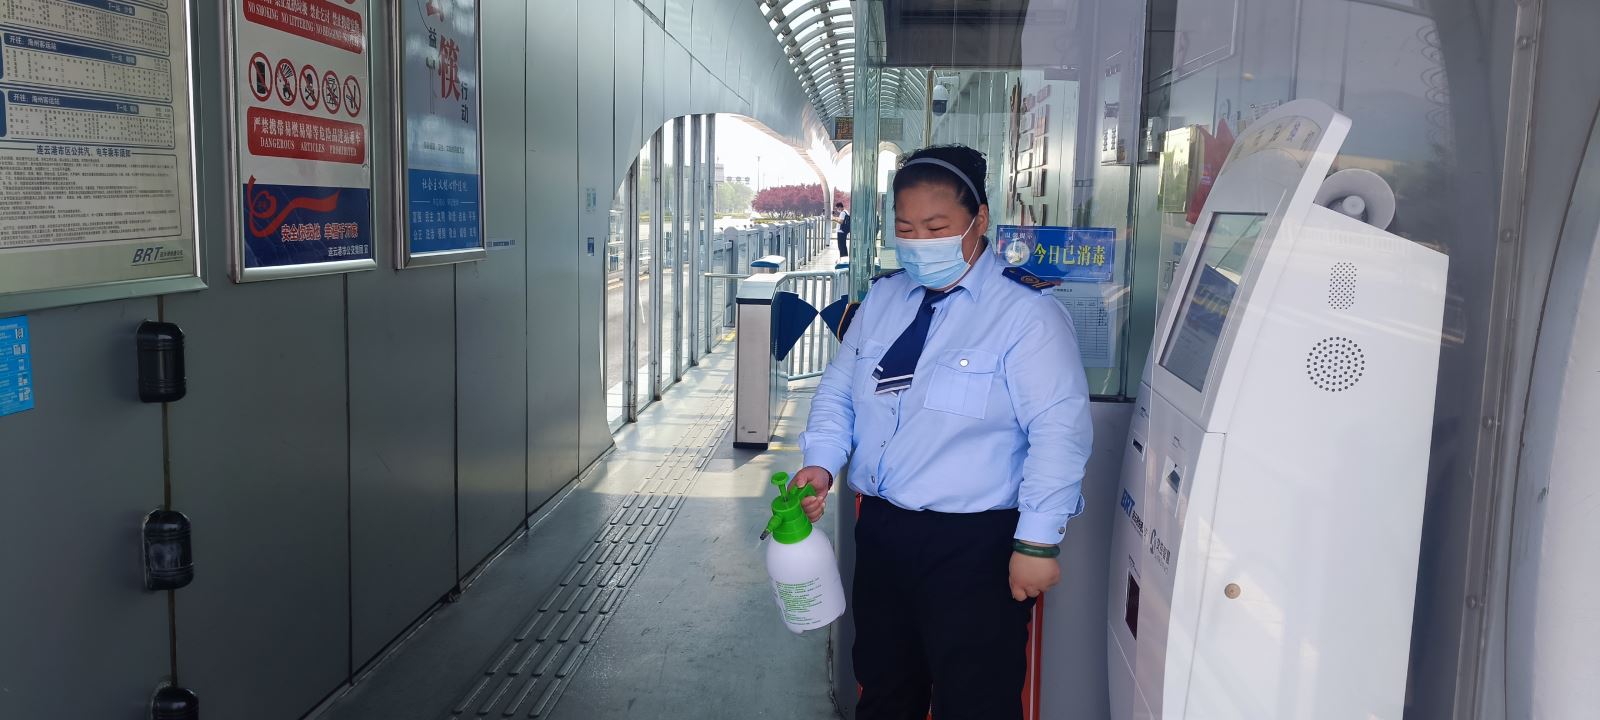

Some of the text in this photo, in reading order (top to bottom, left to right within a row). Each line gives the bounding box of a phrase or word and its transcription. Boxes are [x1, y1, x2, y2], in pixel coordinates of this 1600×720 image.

[461, 81, 469, 124] 行动
[260, 136, 357, 157] DANGEROUS ARTICLES PROHIBITED
[281, 223, 322, 243] 安全你我他
[132, 246, 164, 263] BRT
[1034, 243, 1105, 267] 今日已消毒
